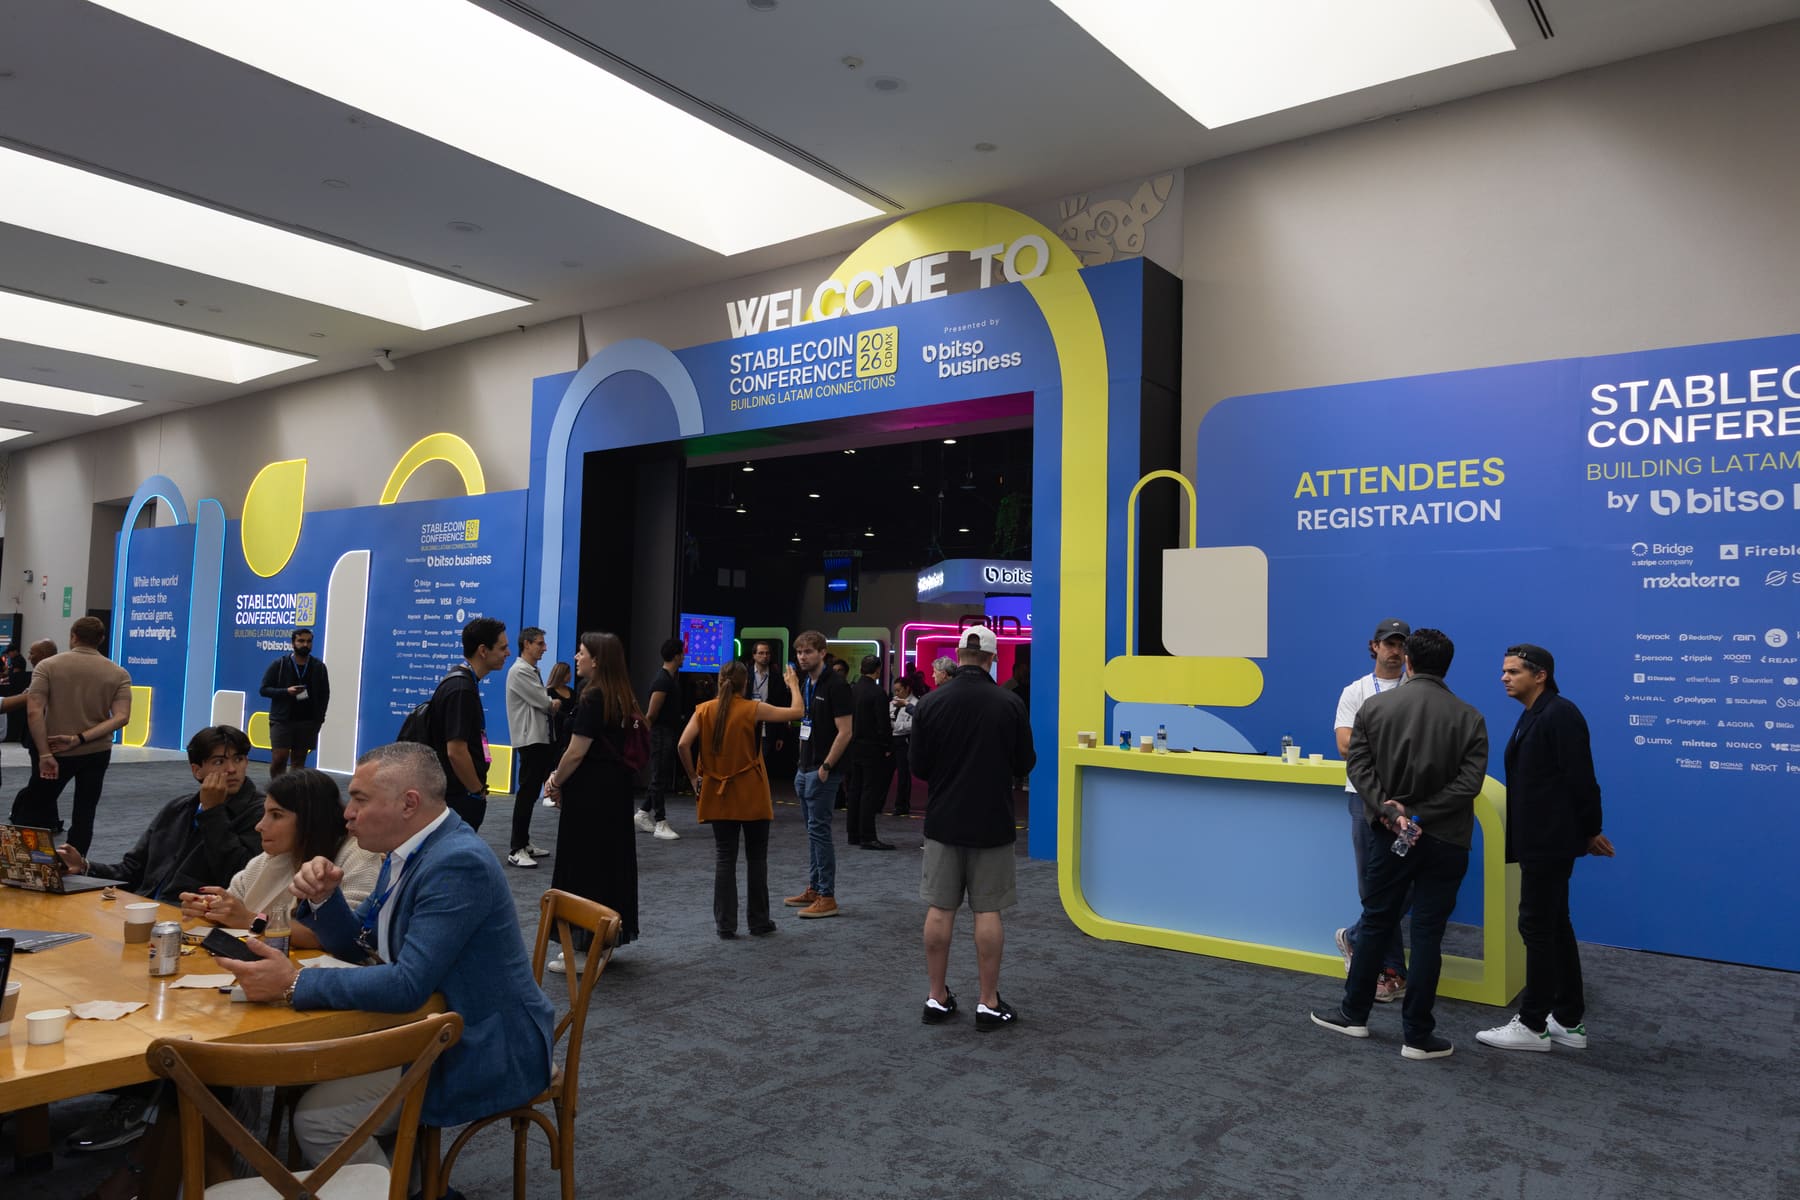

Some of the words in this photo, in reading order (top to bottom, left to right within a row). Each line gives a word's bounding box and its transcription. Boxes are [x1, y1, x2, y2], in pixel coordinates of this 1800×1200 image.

[726, 252, 949, 338] WELCOME
[970, 234, 1049, 289] TO
[944, 320, 986, 333] Presented
[860, 333, 883, 352] 20
[885, 333, 893, 368] CDMX
[939, 340, 984, 360] bitso
[730, 334, 853, 374] STABLECOIN
[860, 352, 882, 371] 26
[939, 354, 1022, 378] business
[730, 360, 853, 395] CONFERENCE
[731, 393, 776, 411] BUILDING
[777, 387, 813, 404] LATAM
[815, 375, 896, 398] CONNECTIONS
[1591, 365, 1800, 416] STABLEC
[1587, 406, 1800, 448] CONFERE
[1587, 457, 1702, 481] BUILDING
[1711, 451, 1800, 473] LATAM
[1294, 457, 1505, 498] ATTENDEES
[1607, 491, 1639, 513] by
[1686, 485, 1785, 515] bitso
[1297, 499, 1501, 530] REGISTRATION
[421, 521, 465, 534] STABLECOIN
[421, 532, 465, 544] CONFERENCE
[1652, 543, 1694, 557] Bridge
[434, 555, 455, 567] bitso
[455, 553, 492, 566] business
[1637, 559, 1657, 567] stripe
[1658, 559, 1694, 567] company
[150, 576, 160, 587] the
[161, 575, 179, 587] world
[132, 593, 156, 604] watches
[157, 592, 168, 604] the
[236, 593, 297, 610] STABLECOIN
[235, 611, 296, 625] CONFERENCE
[1636, 632, 1671, 641] Keyrock
[1689, 654, 1713, 662] ripple
[1684, 696, 1717, 704] polygon
[1682, 739, 1718, 748] minteo
[1726, 741, 1762, 749] NONCO
